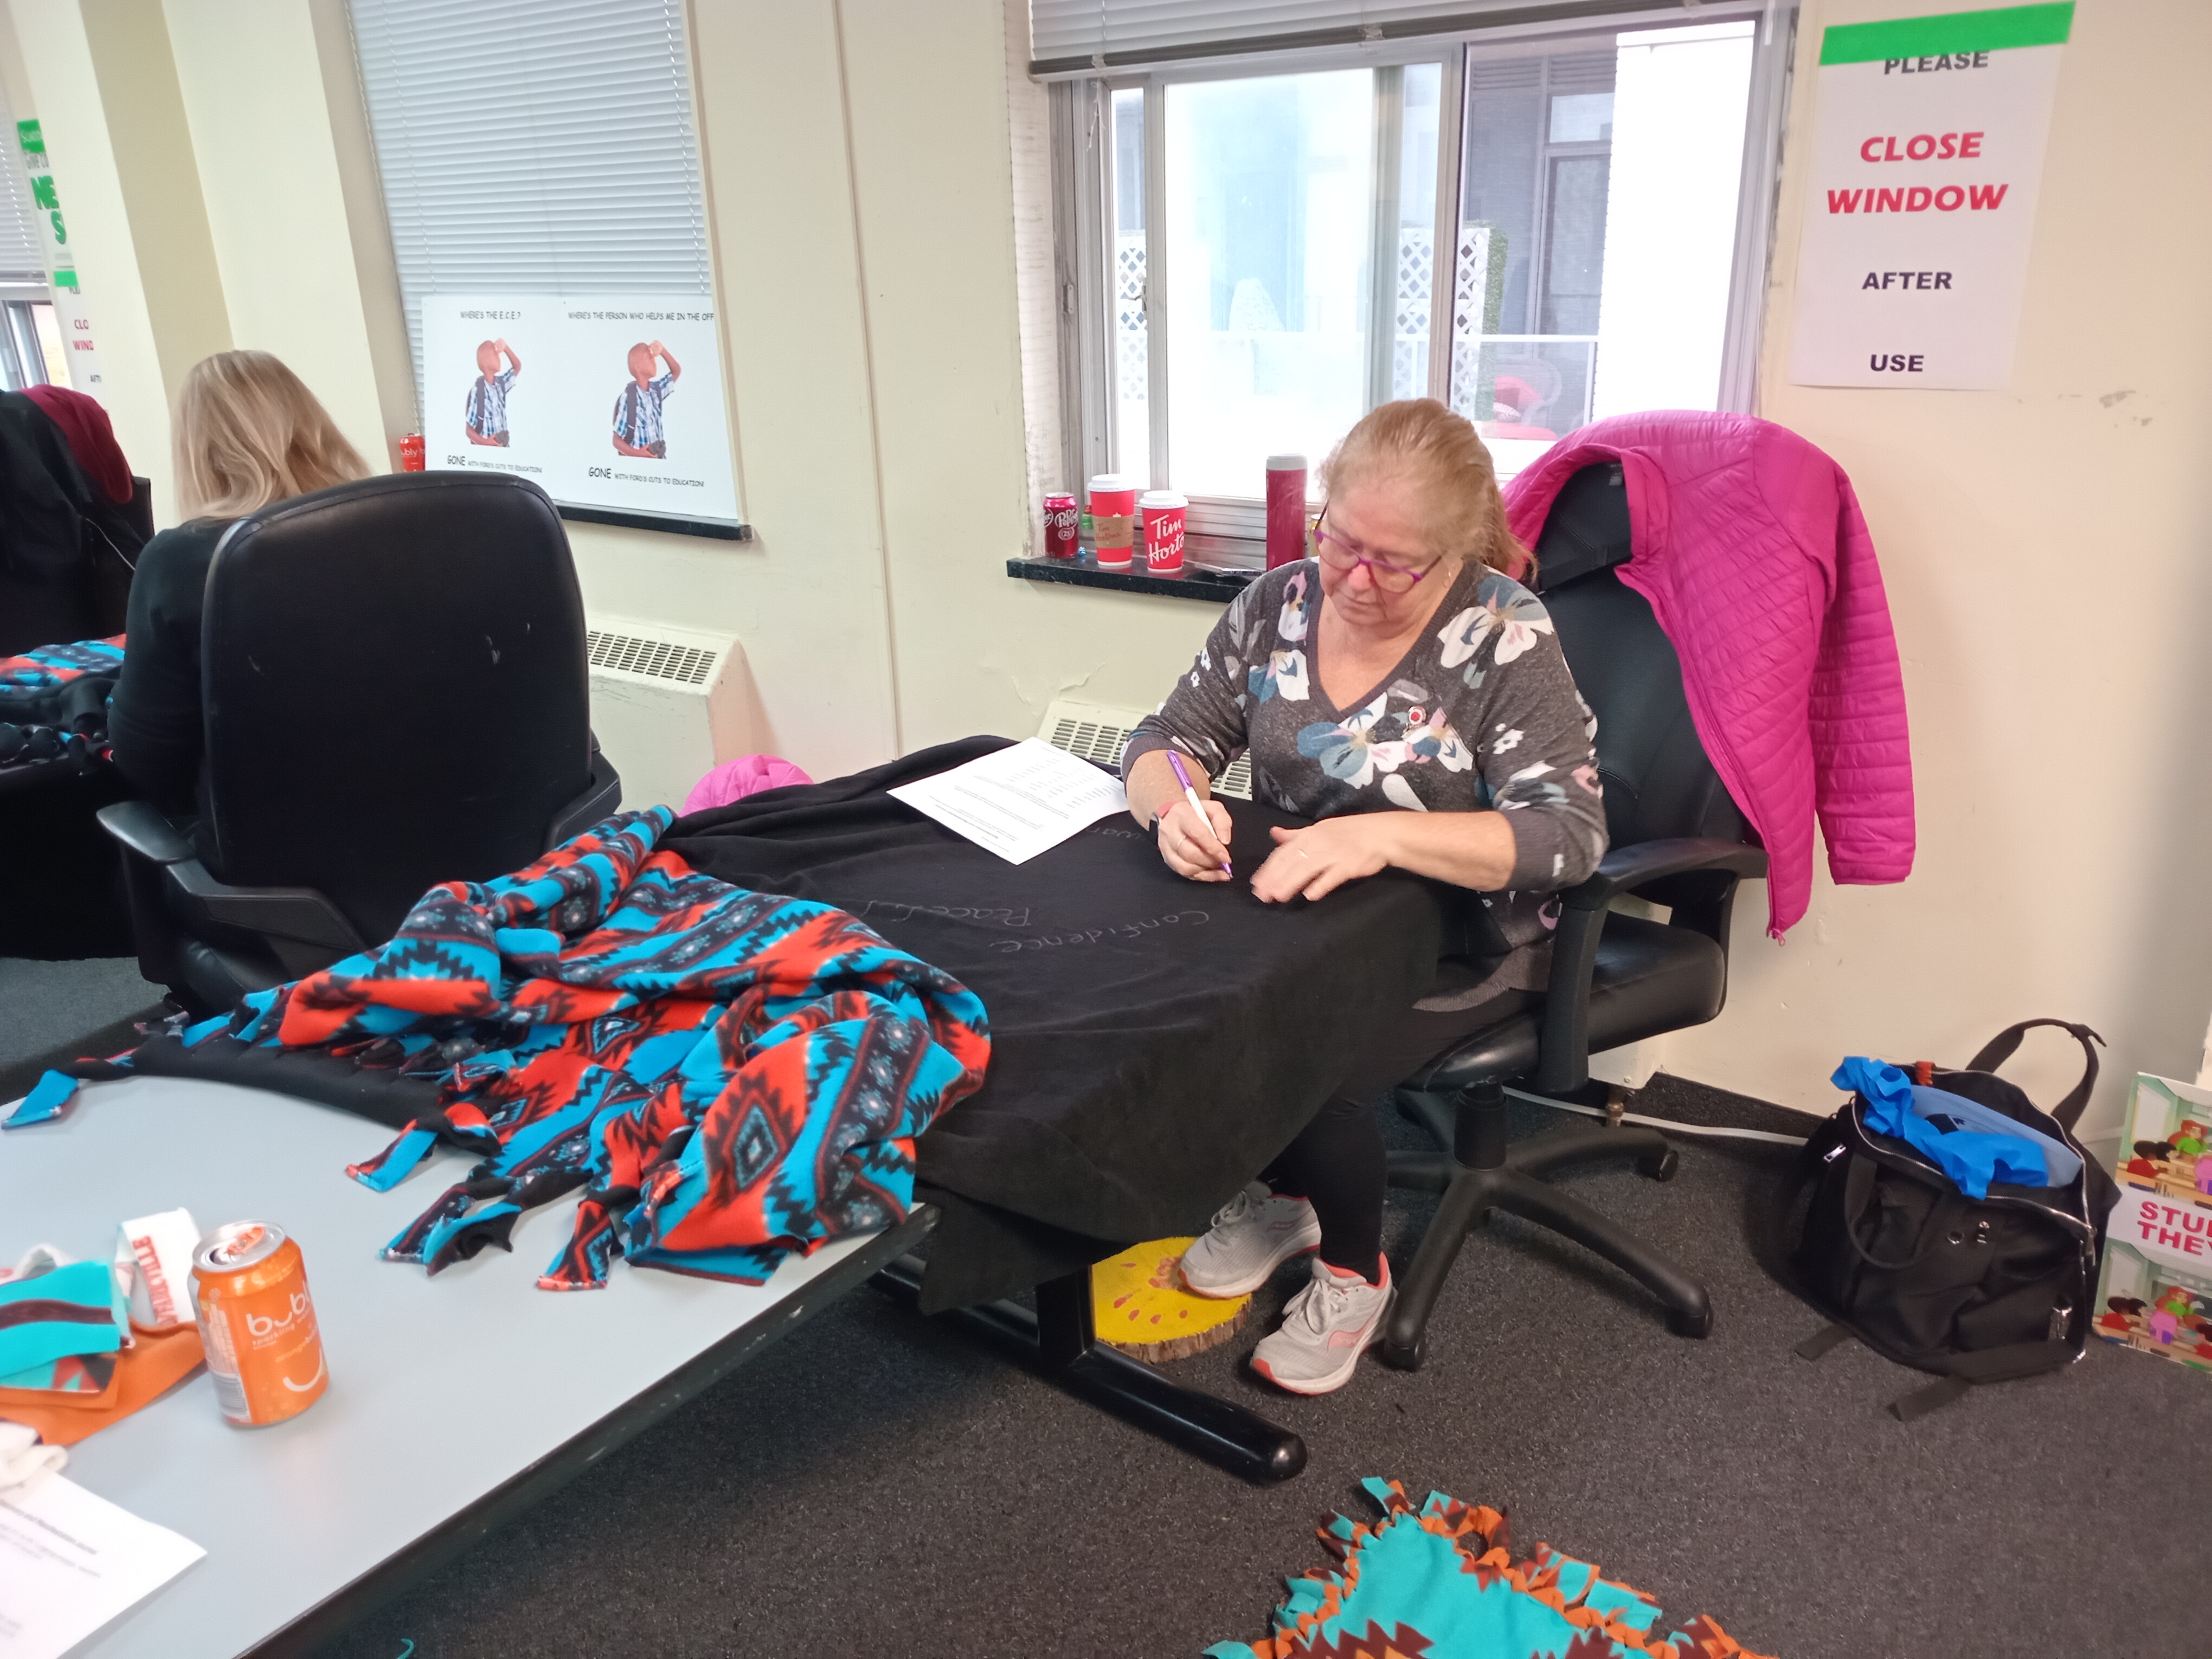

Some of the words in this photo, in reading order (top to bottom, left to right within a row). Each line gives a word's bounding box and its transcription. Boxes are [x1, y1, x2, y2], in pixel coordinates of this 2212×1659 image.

[1883, 49, 1990, 75] PLEASE
[1860, 131, 1984, 163] CLOSE
[1827, 184, 2009, 215] WINDOW
[1861, 272, 1953, 290] AFTER
[486, 311, 498, 320] THE
[568, 311, 591, 320] WHERE'S
[593, 311, 604, 320] THE
[605, 311, 628, 320] PERSON
[629, 312, 644, 320] WHO
[665, 312, 675, 321] ME
[677, 312, 685, 320] IN
[686, 312, 700, 321] THE
[702, 313, 715, 321] OFF
[1869, 354, 1924, 372] USE
[447, 455, 466, 466] GONE
[589, 467, 612, 479] GONE
[1150, 514, 1182, 539] Tim
[988, 910, 1210, 953] Confidence
[2137, 1220, 2212, 1256] THE
